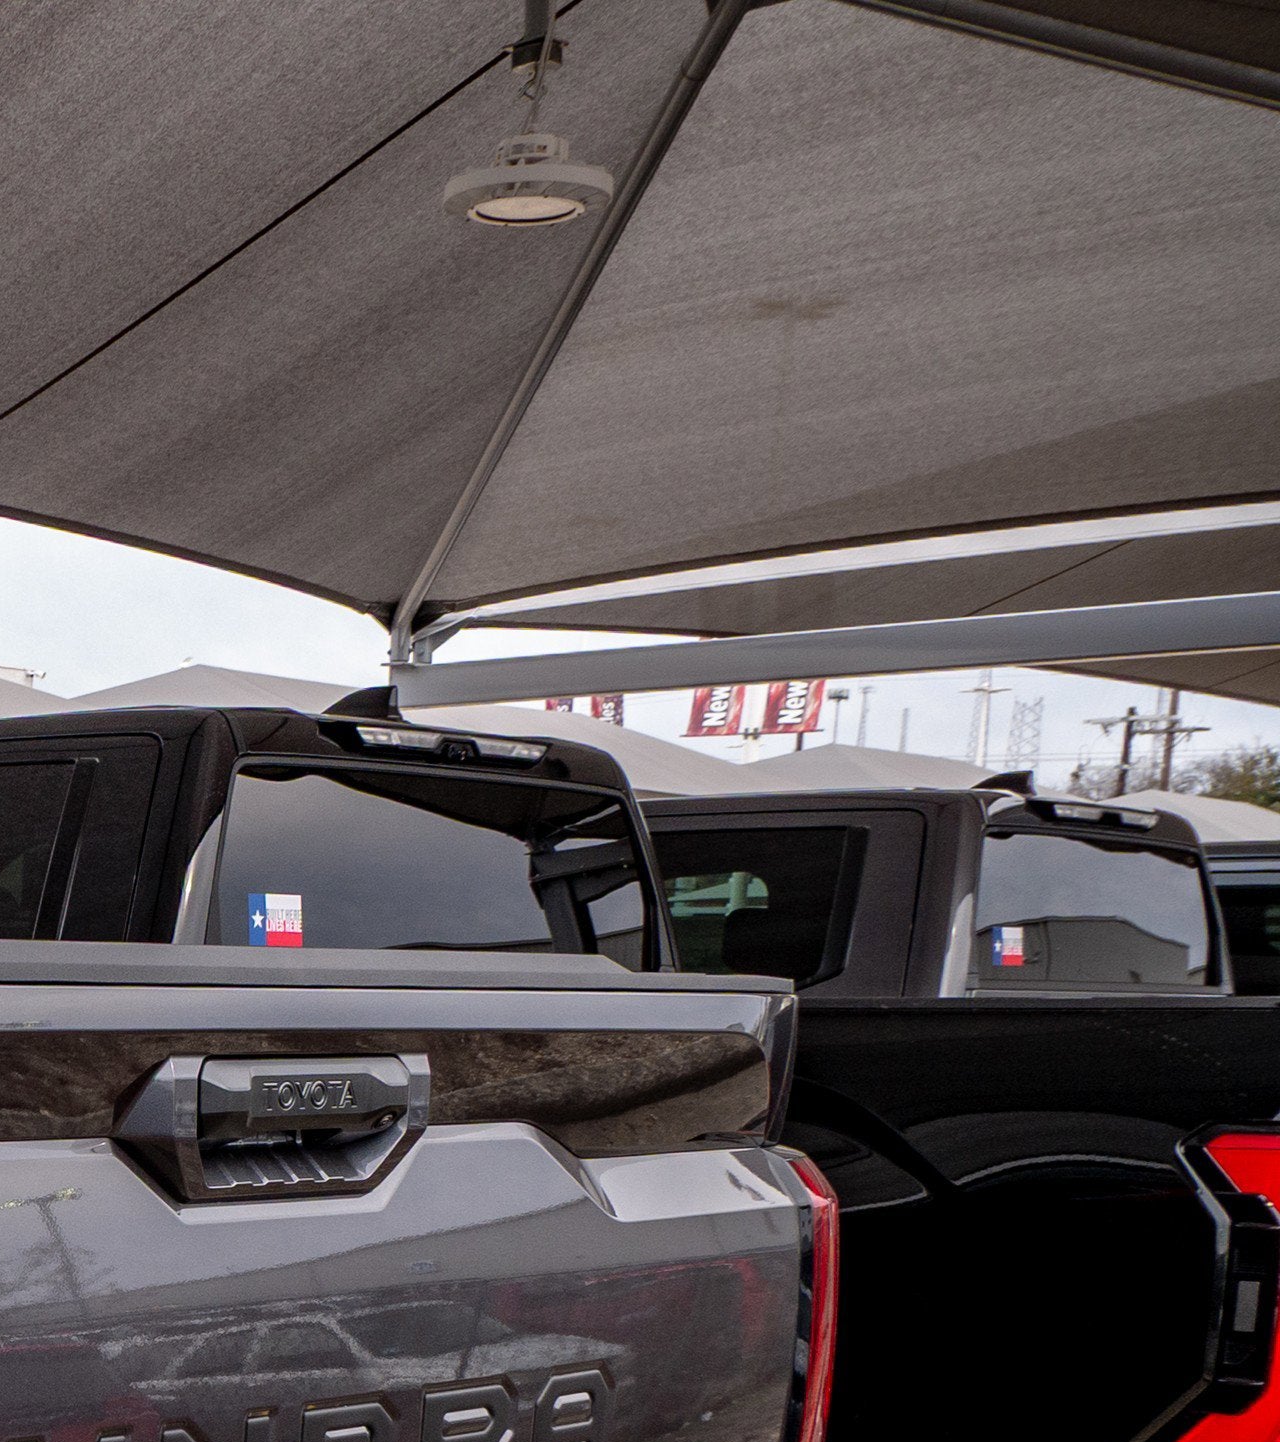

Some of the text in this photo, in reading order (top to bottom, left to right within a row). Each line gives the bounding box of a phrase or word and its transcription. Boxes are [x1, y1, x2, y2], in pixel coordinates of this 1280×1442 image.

[702, 686, 732, 727] New
[777, 681, 809, 725] New
[262, 1080, 358, 1112] TOYOTA
